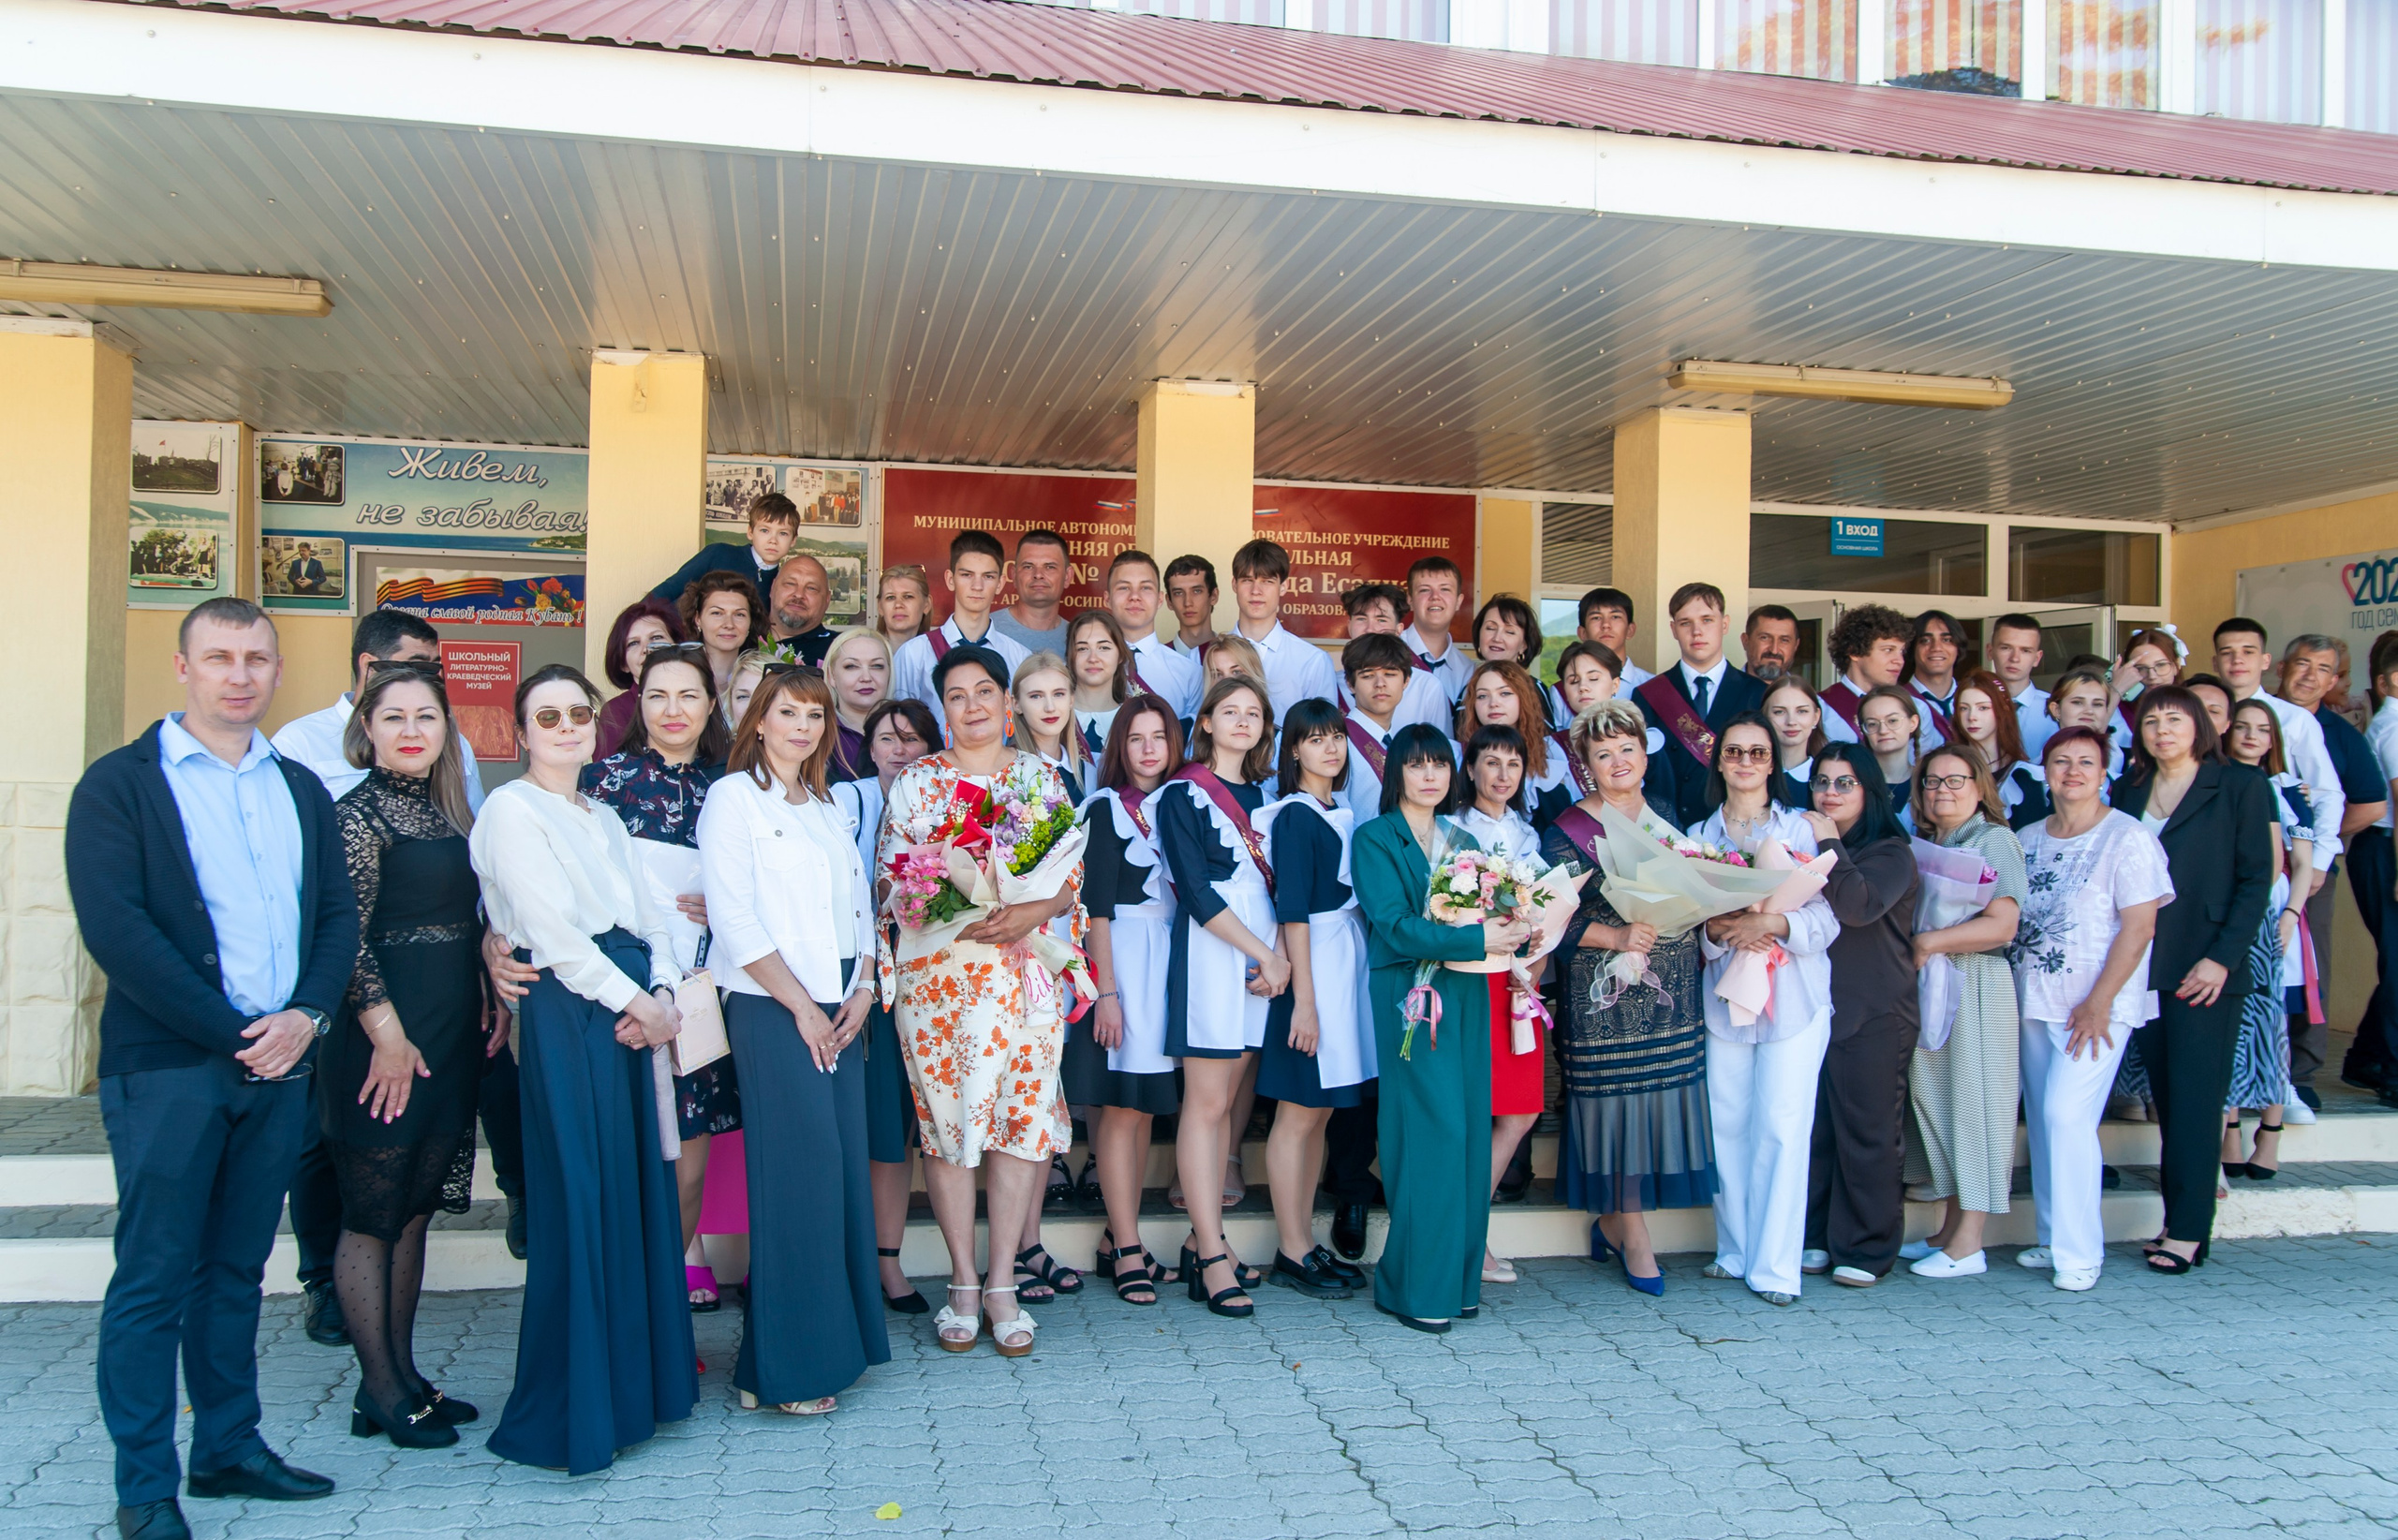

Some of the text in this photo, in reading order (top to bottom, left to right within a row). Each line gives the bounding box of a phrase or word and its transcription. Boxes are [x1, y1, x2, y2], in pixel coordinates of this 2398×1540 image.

[388, 447, 549, 488] Живем,
[356, 497, 587, 533] не забывая!
[913, 515, 1056, 533] МУНИЦИПАЛЬНОЕ
[1836, 521, 1878, 537] 1 ВХОД
[1067, 540, 1109, 557] НЯЯ
[1354, 534, 1450, 550] УЧРЕЖДЕНИЕ
[1287, 549, 1352, 567] ЛЬНАЯ
[431, 605, 475, 619] славой
[474, 604, 524, 624] родная
[525, 606, 574, 626] Кубань
[1282, 603, 1346, 616] ОБРАЗОВ
[448, 651, 511, 661] ШКОЛЬНЫЙ
[450, 663, 509, 672] ЛИТЕРАТУРНО-
[447, 673, 511, 681] КРАЕВЕДЧЕСКИЙ
[466, 681, 492, 689] МУЗЕЙ
